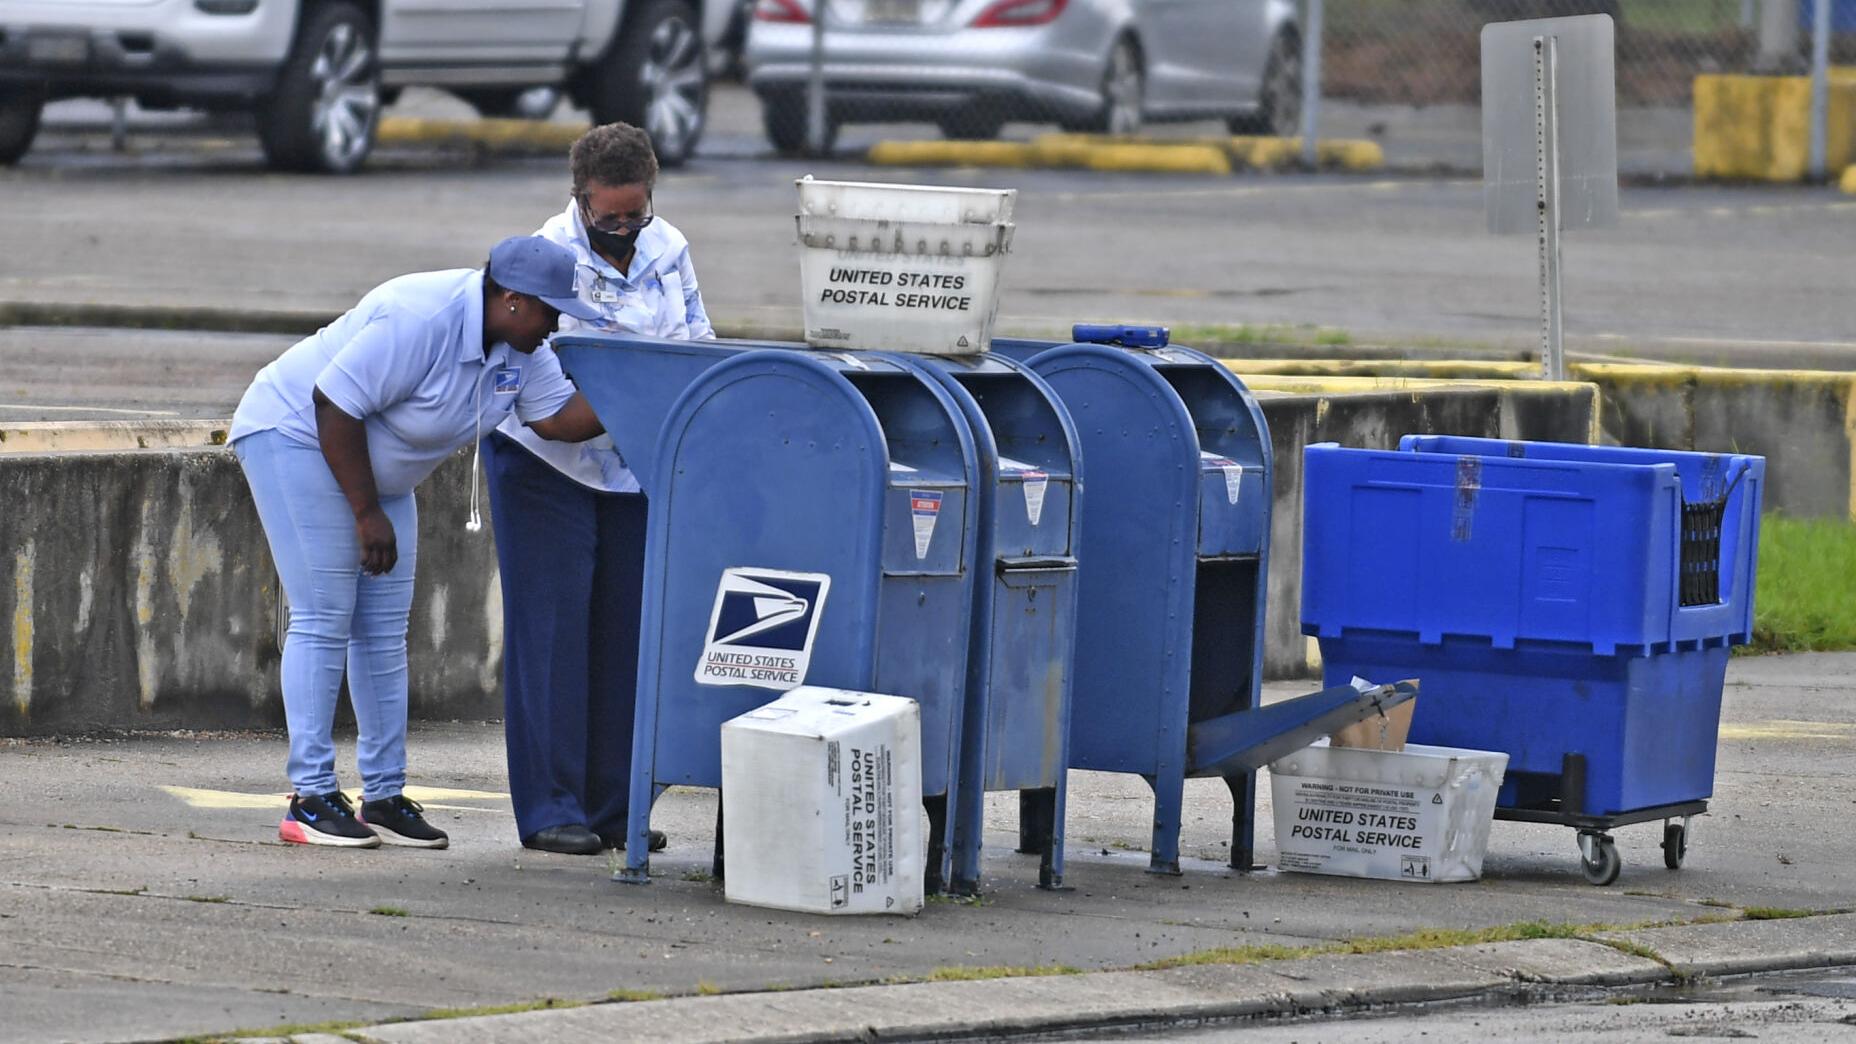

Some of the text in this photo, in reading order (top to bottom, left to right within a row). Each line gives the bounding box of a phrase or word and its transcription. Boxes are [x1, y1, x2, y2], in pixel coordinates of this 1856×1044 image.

[829, 268, 965, 290] UNITED STATES
[821, 288, 971, 311] POSTAL SERVICE
[708, 652, 795, 668] UNITED STATES
[704, 665, 798, 682] POSTAL SERVICE
[1301, 783, 1334, 791] WARNING
[1339, 785, 1353, 793] NOT
[1355, 787, 1370, 795] FOR
[1370, 788, 1399, 798] PRIVATE
[1400, 791, 1415, 799] USE
[851, 748, 864, 894] POSTAL SERVICE
[864, 752, 876, 884] UNITED STATES
[1299, 807, 1417, 831] UNITED STATES
[1291, 825, 1423, 849] POSTAL SERVICE
[1361, 848, 1377, 856] ONLY
